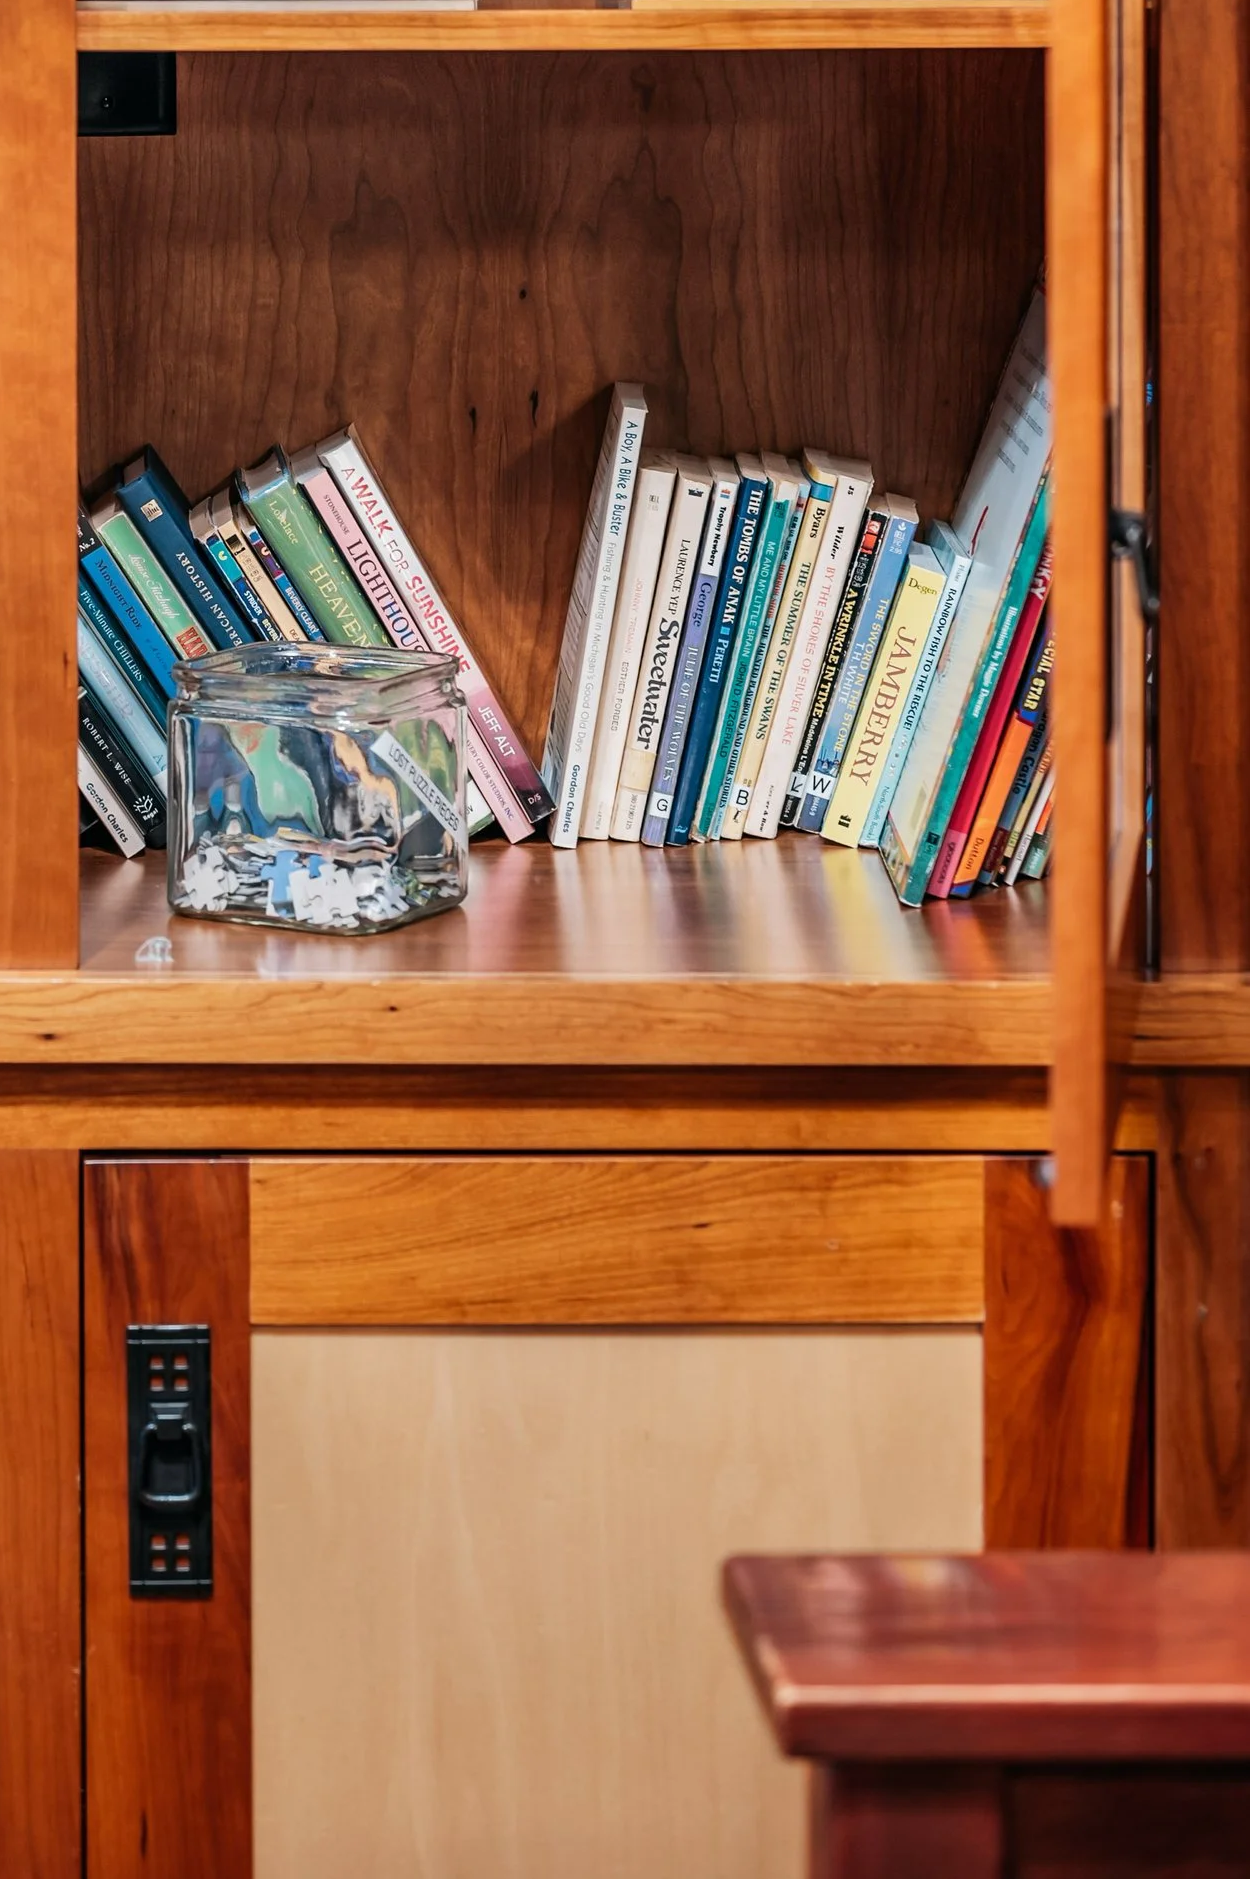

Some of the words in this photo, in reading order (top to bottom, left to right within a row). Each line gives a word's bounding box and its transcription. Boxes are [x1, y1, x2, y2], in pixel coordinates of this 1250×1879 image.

[323, 494, 350, 535] STONEHOUSE
[748, 490, 763, 514] THE
[736, 517, 757, 563] TOMBS
[810, 508, 826, 538] Byars
[831, 526, 844, 560] Wilder
[673, 539, 690, 593] LAURENCE
[733, 566, 745, 584] OF
[908, 577, 938, 595] Degen
[668, 594, 679, 615] YEP
[693, 582, 712, 627] George
[722, 586, 741, 623] ANAK
[934, 588, 956, 636] RAINBOW
[709, 639, 729, 683] PERETTI
[928, 637, 941, 657] FISH
[923, 658, 934, 673] TO
[637, 618, 679, 749] Sweetwater
[918, 676, 928, 694] THE
[849, 626, 916, 786] JAMBERRY
[905, 696, 920, 730] RESCUE!
[478, 706, 501, 734] JEFF
[494, 736, 515, 757] ALT
[569, 764, 581, 799] Gordon
[86, 782, 108, 814] Gordon
[107, 814, 129, 843] Charles
[562, 801, 575, 833] Charles
